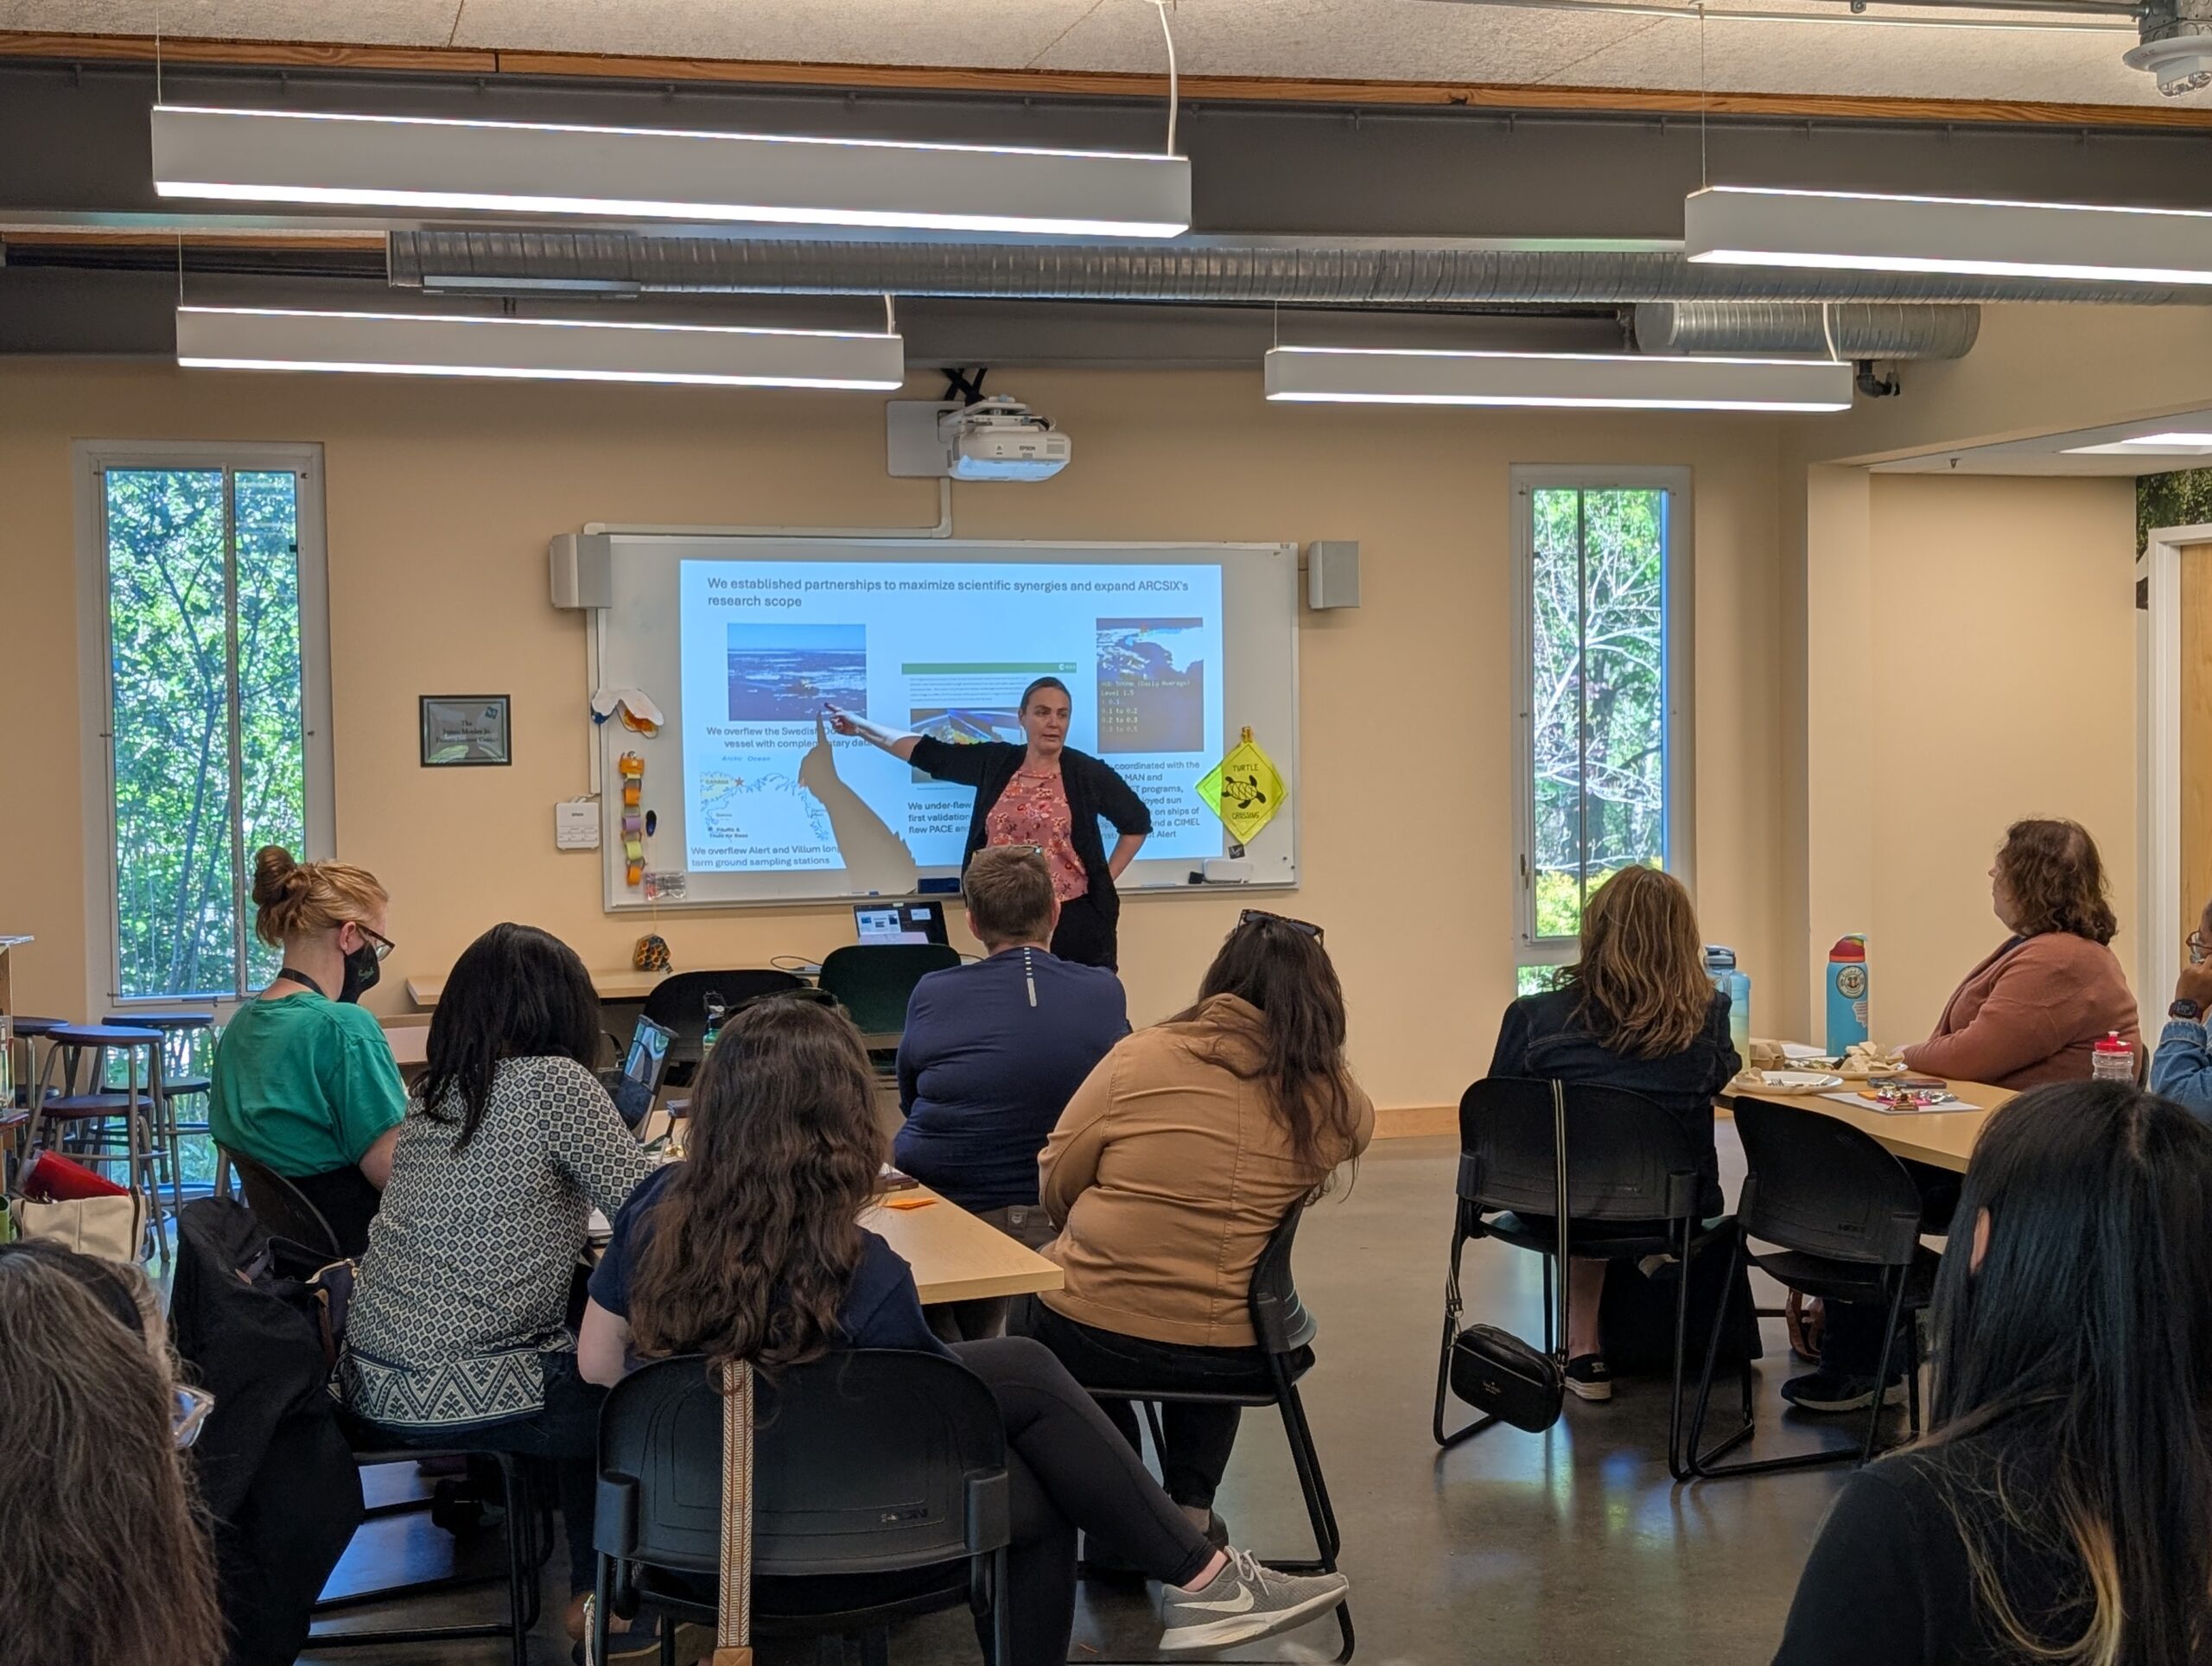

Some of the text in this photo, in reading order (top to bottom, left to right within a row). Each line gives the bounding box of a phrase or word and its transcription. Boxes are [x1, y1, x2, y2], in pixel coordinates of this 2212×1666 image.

[708, 578, 1188, 593] We established partnerships to maximize scientific synergies and expand ARCSIX's
[708, 595, 802, 608] research scope
[707, 727, 721, 735] We
[724, 727, 763, 735] overflew
[765, 727, 779, 735] the
[724, 740, 753, 748] vessel
[756, 739, 775, 748] with
[1115, 761, 1165, 770] coordinated
[925, 802, 971, 811] under-flew
[1167, 808, 1189, 817] ships
[927, 813, 969, 822] validation
[929, 825, 953, 834] PACE
[708, 846, 747, 855] overflew
[748, 845, 770, 855] Alert
[772, 845, 790, 854] and
[791, 844, 821, 854] Villum
[823, 844, 840, 854] lon
[715, 858, 747, 868] ground
[749, 857, 791, 868] sampling
[793, 856, 830, 865] stations
